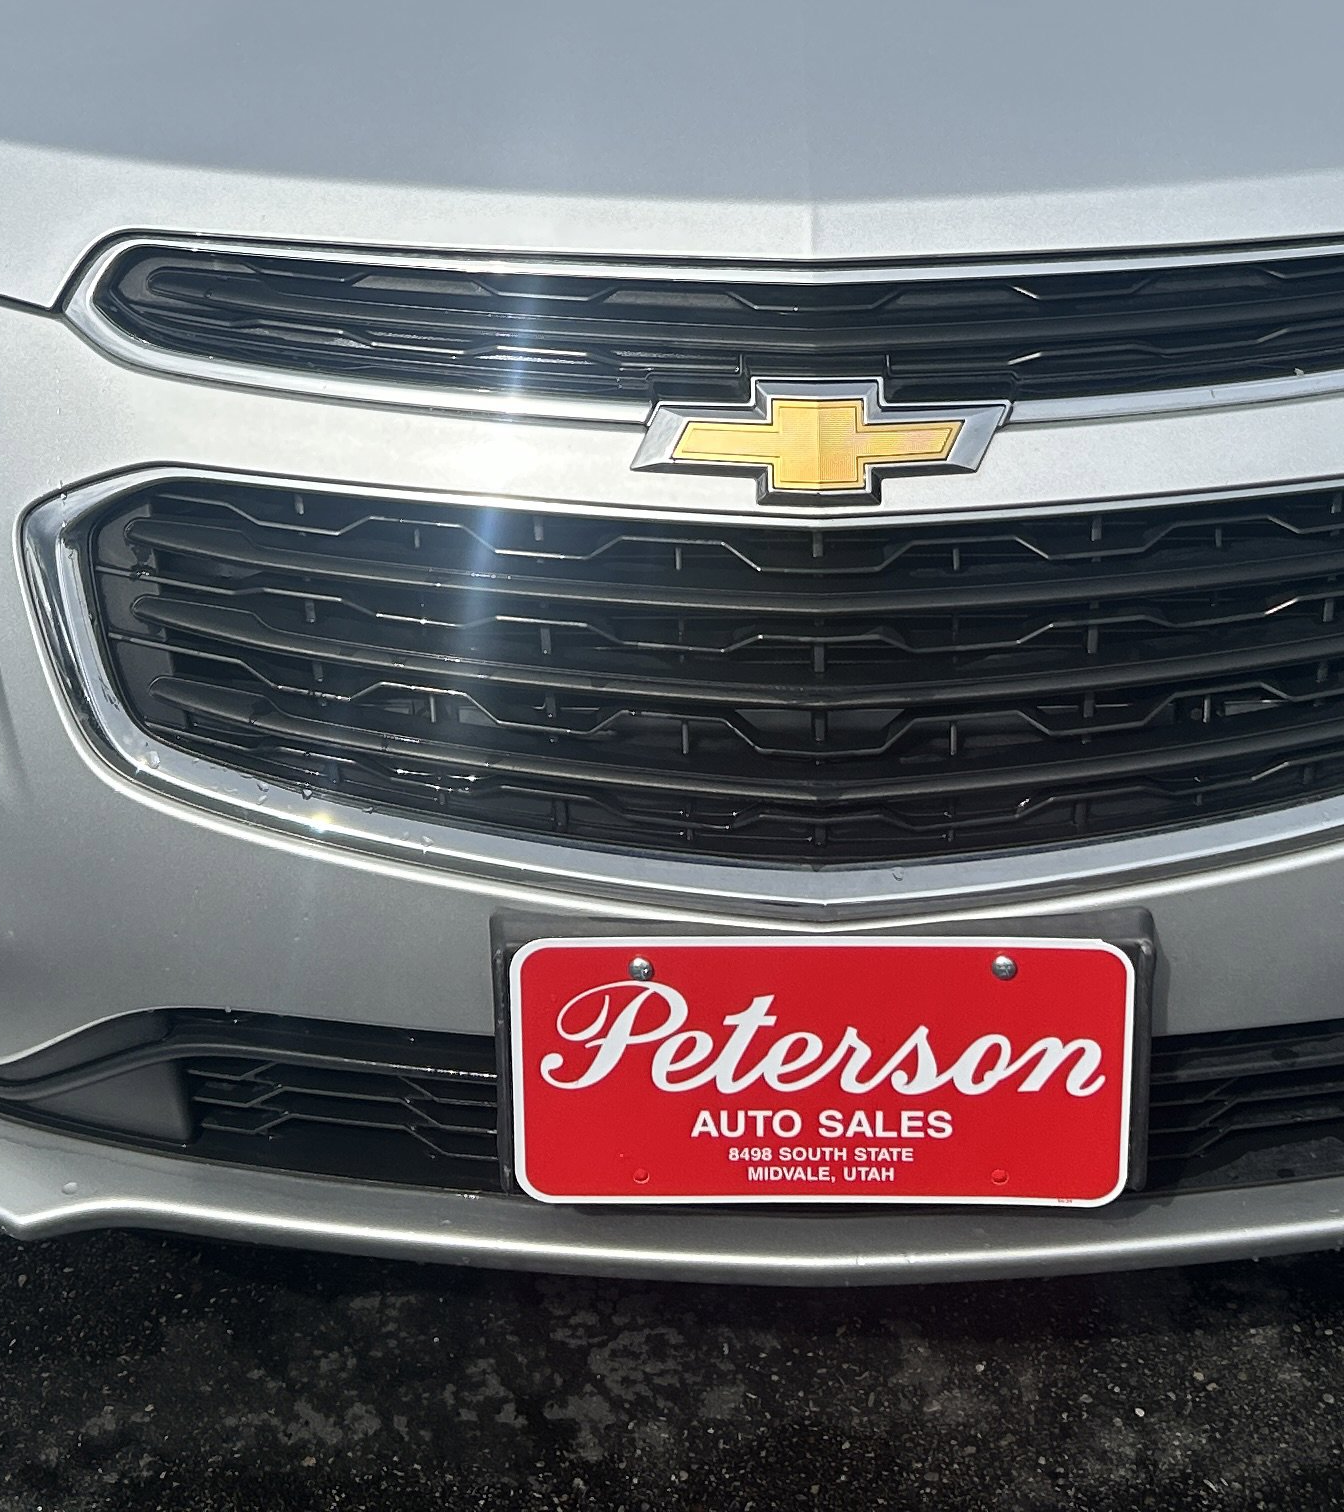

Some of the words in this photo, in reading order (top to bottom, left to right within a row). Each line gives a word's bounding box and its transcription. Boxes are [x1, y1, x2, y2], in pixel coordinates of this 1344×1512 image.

[540, 980, 1106, 1096] Peterson
[691, 1110, 802, 1138] AUTO
[818, 1110, 954, 1138] SALES
[728, 1147, 773, 1161] 8498
[779, 1147, 847, 1161] SOUTH
[854, 1147, 914, 1161] STATE
[748, 1166, 836, 1183] MIDVALE,
[843, 1166, 895, 1181] UTAH
